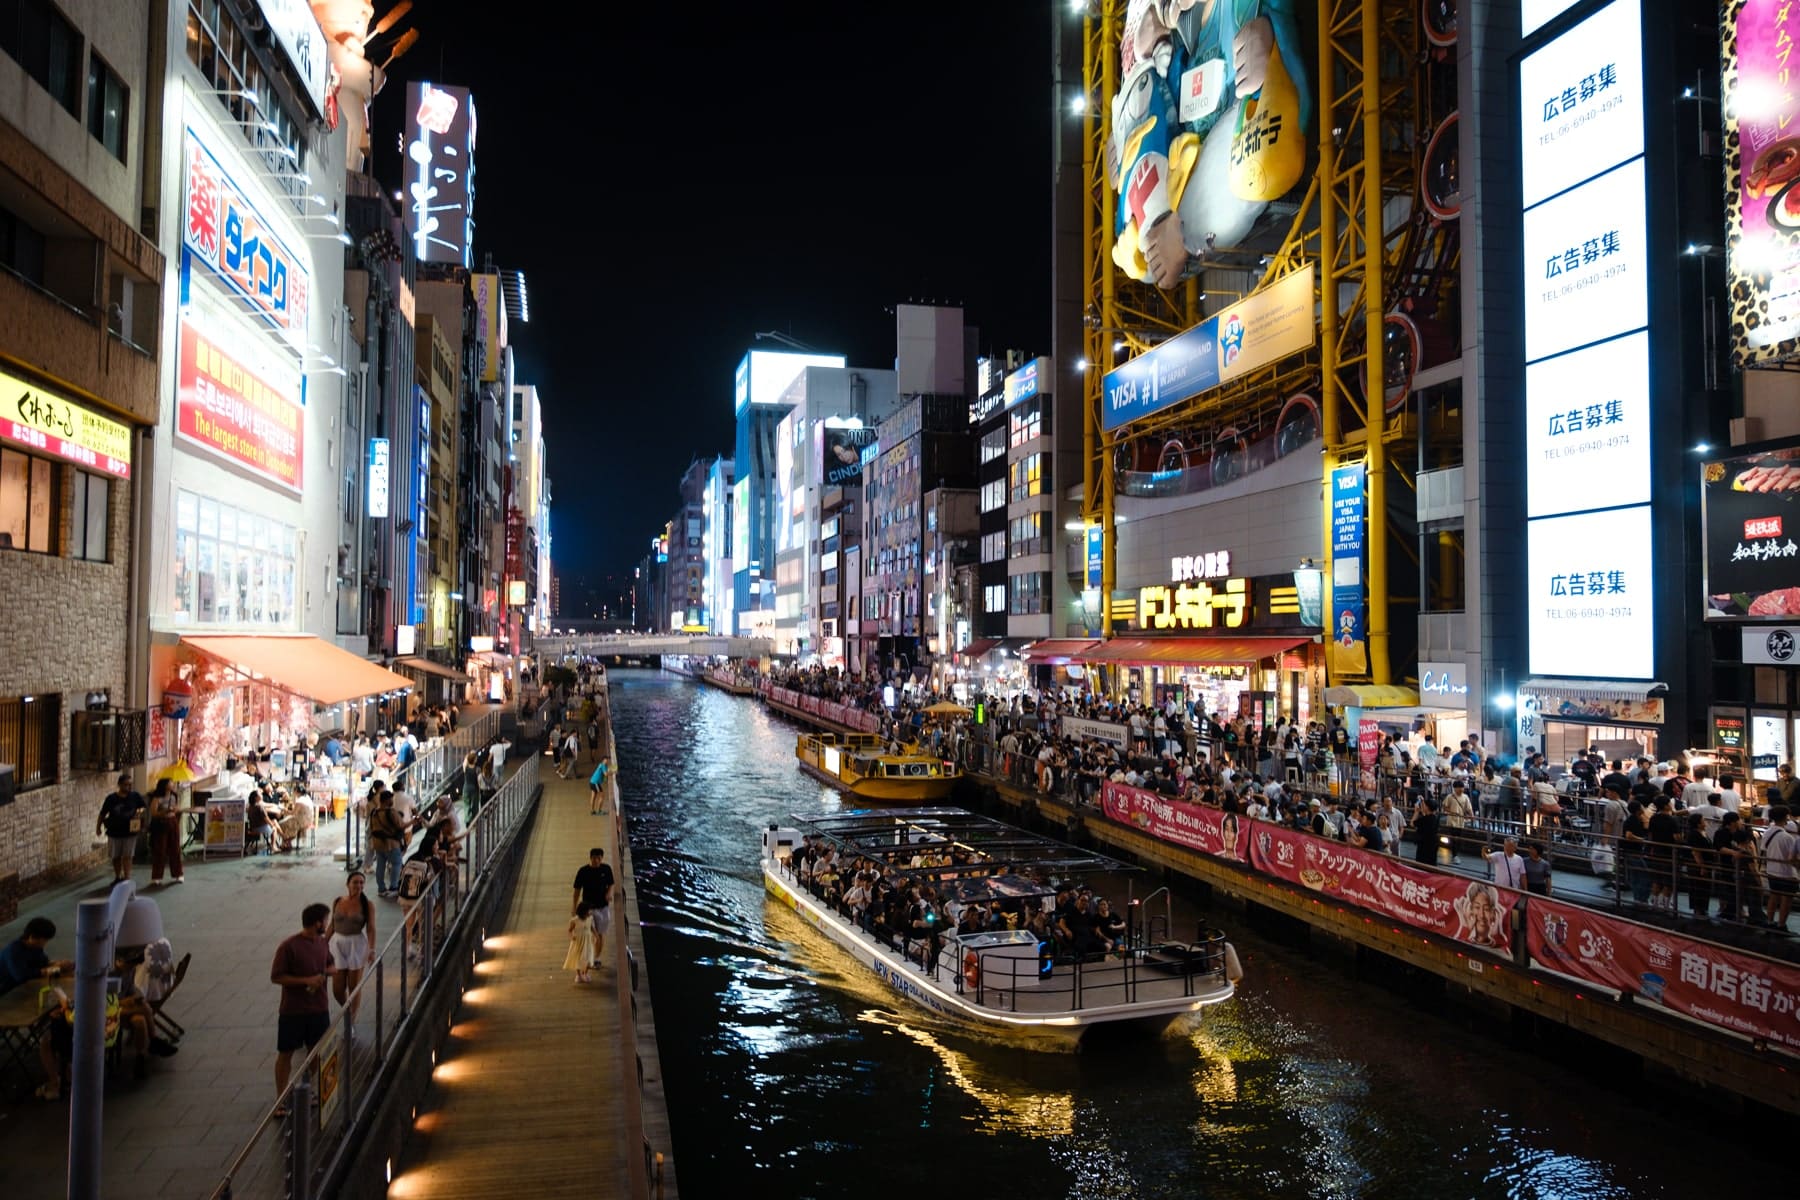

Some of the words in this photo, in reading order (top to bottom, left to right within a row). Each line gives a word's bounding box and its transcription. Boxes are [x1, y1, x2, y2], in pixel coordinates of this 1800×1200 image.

[1543, 63, 1617, 122] 広告募集
[190, 147, 217, 251] 薬
[1545, 230, 1621, 279] 広告募集
[1110, 379, 1137, 410] VISA
[1548, 399, 1624, 437] 広告募集
[195, 409, 211, 437] The
[212, 418, 238, 451] largest
[240, 439, 257, 461] store
[1338, 475, 1358, 490] VISA
[1334, 499, 1345, 509] USE
[1345, 497, 1361, 507] YOUR
[1341, 507, 1354, 516] VISA
[1334, 517, 1346, 526] AND
[1346, 515, 1360, 524] TAKE
[1339, 524, 1356, 534] JAPAN
[1334, 542, 1348, 552] WITH
[1348, 541, 1360, 550] YOU
[1340, 533, 1354, 542] BACK
[1550, 570, 1626, 597] 広告募集
[891, 971, 909, 997] STAR
[1690, 1003, 1724, 1023] Speaking
